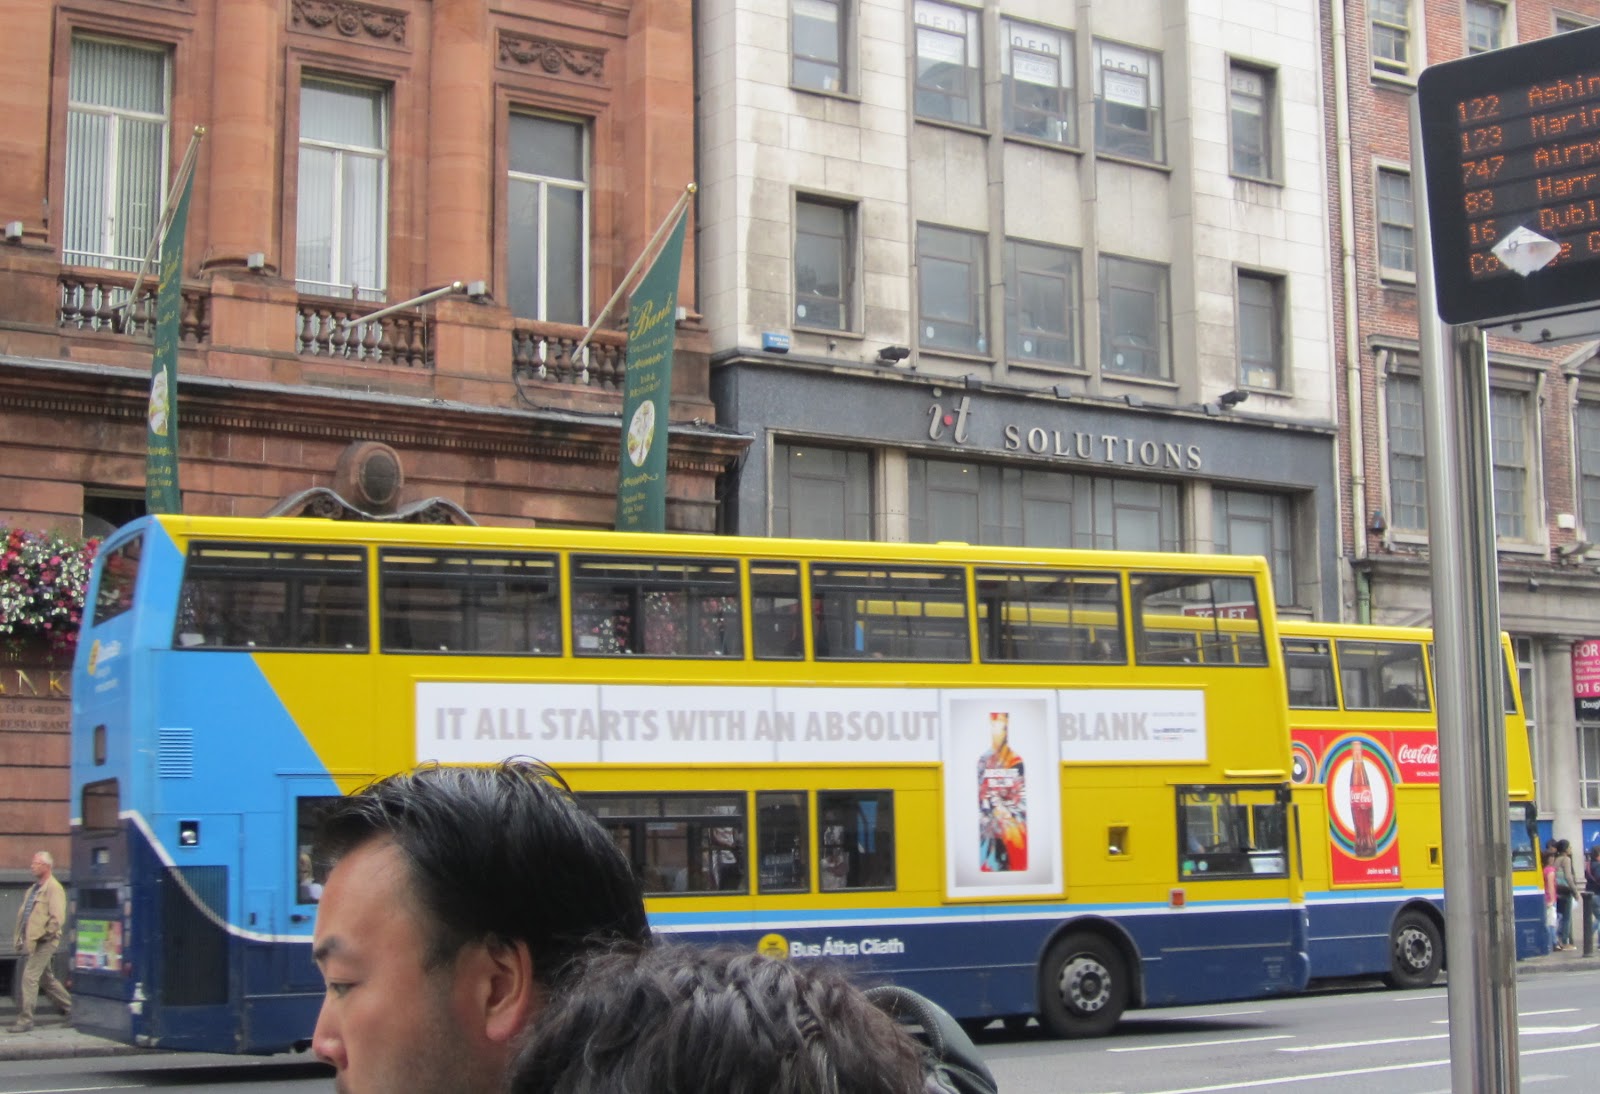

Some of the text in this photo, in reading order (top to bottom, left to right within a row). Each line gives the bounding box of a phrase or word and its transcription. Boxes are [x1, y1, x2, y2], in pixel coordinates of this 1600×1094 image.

[1458, 95, 1499, 123] 122
[1462, 126, 1502, 152] 123
[1462, 155, 1505, 184] 747
[1469, 220, 1497, 244] 16
[1004, 424, 1202, 471] SOLUTIONS
[1576, 682, 1590, 694] 01
[435, 707, 1150, 742] IT ALL STARTS WITH AN ABSOLUT BLANK
[790, 936, 905, 957] Bus Átha Cliath
